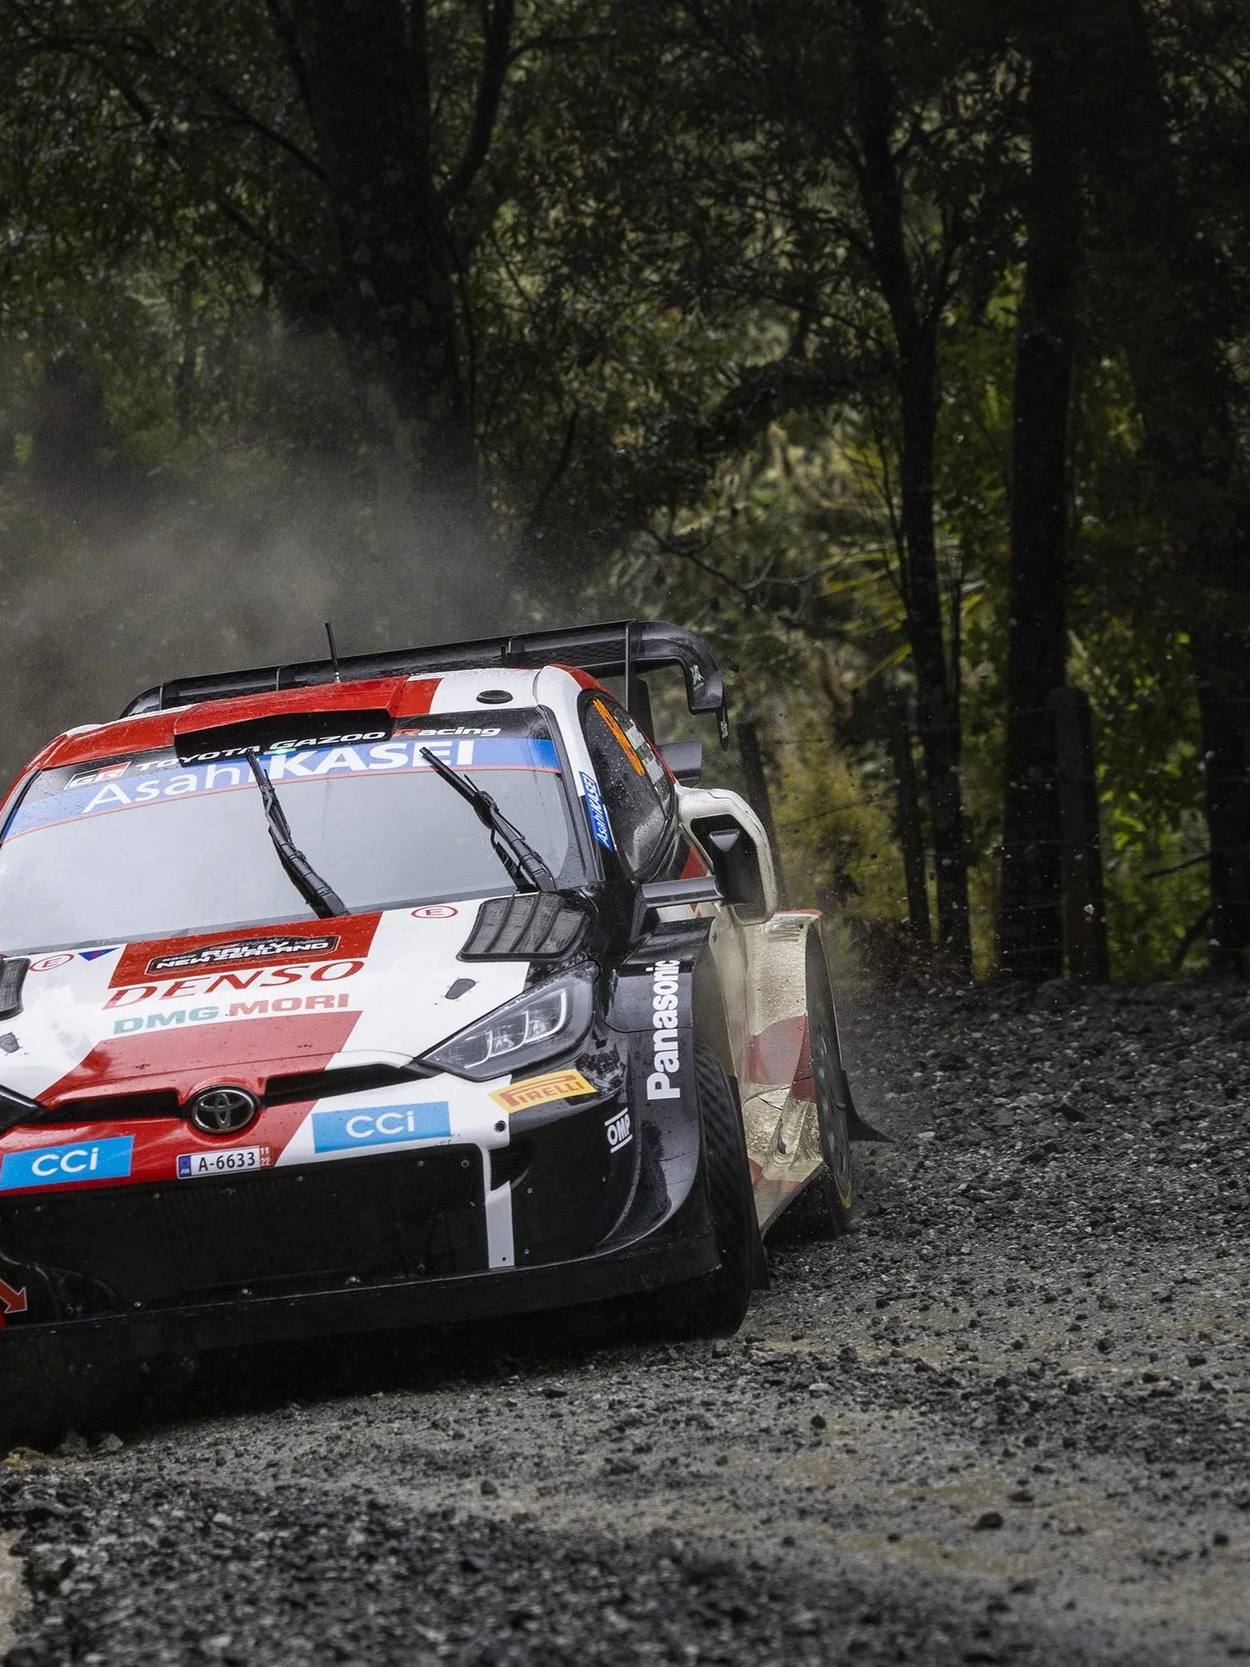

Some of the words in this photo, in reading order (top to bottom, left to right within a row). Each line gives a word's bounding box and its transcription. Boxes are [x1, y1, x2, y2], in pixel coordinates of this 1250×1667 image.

[136, 745, 260, 771] TOYOTA
[269, 731, 386, 750] GAZOO
[393, 726, 502, 738] Racing
[156, 957, 211, 969] NEW
[102, 960, 365, 1011] DENSO
[113, 1006, 220, 1035] DMG
[228, 993, 349, 1017] MORI
[646, 960, 681, 1101] Panasonic
[500, 1074, 586, 1108] PIRELLI
[607, 1113, 631, 1146] OMP
[198, 1151, 256, 1172] A-6633
